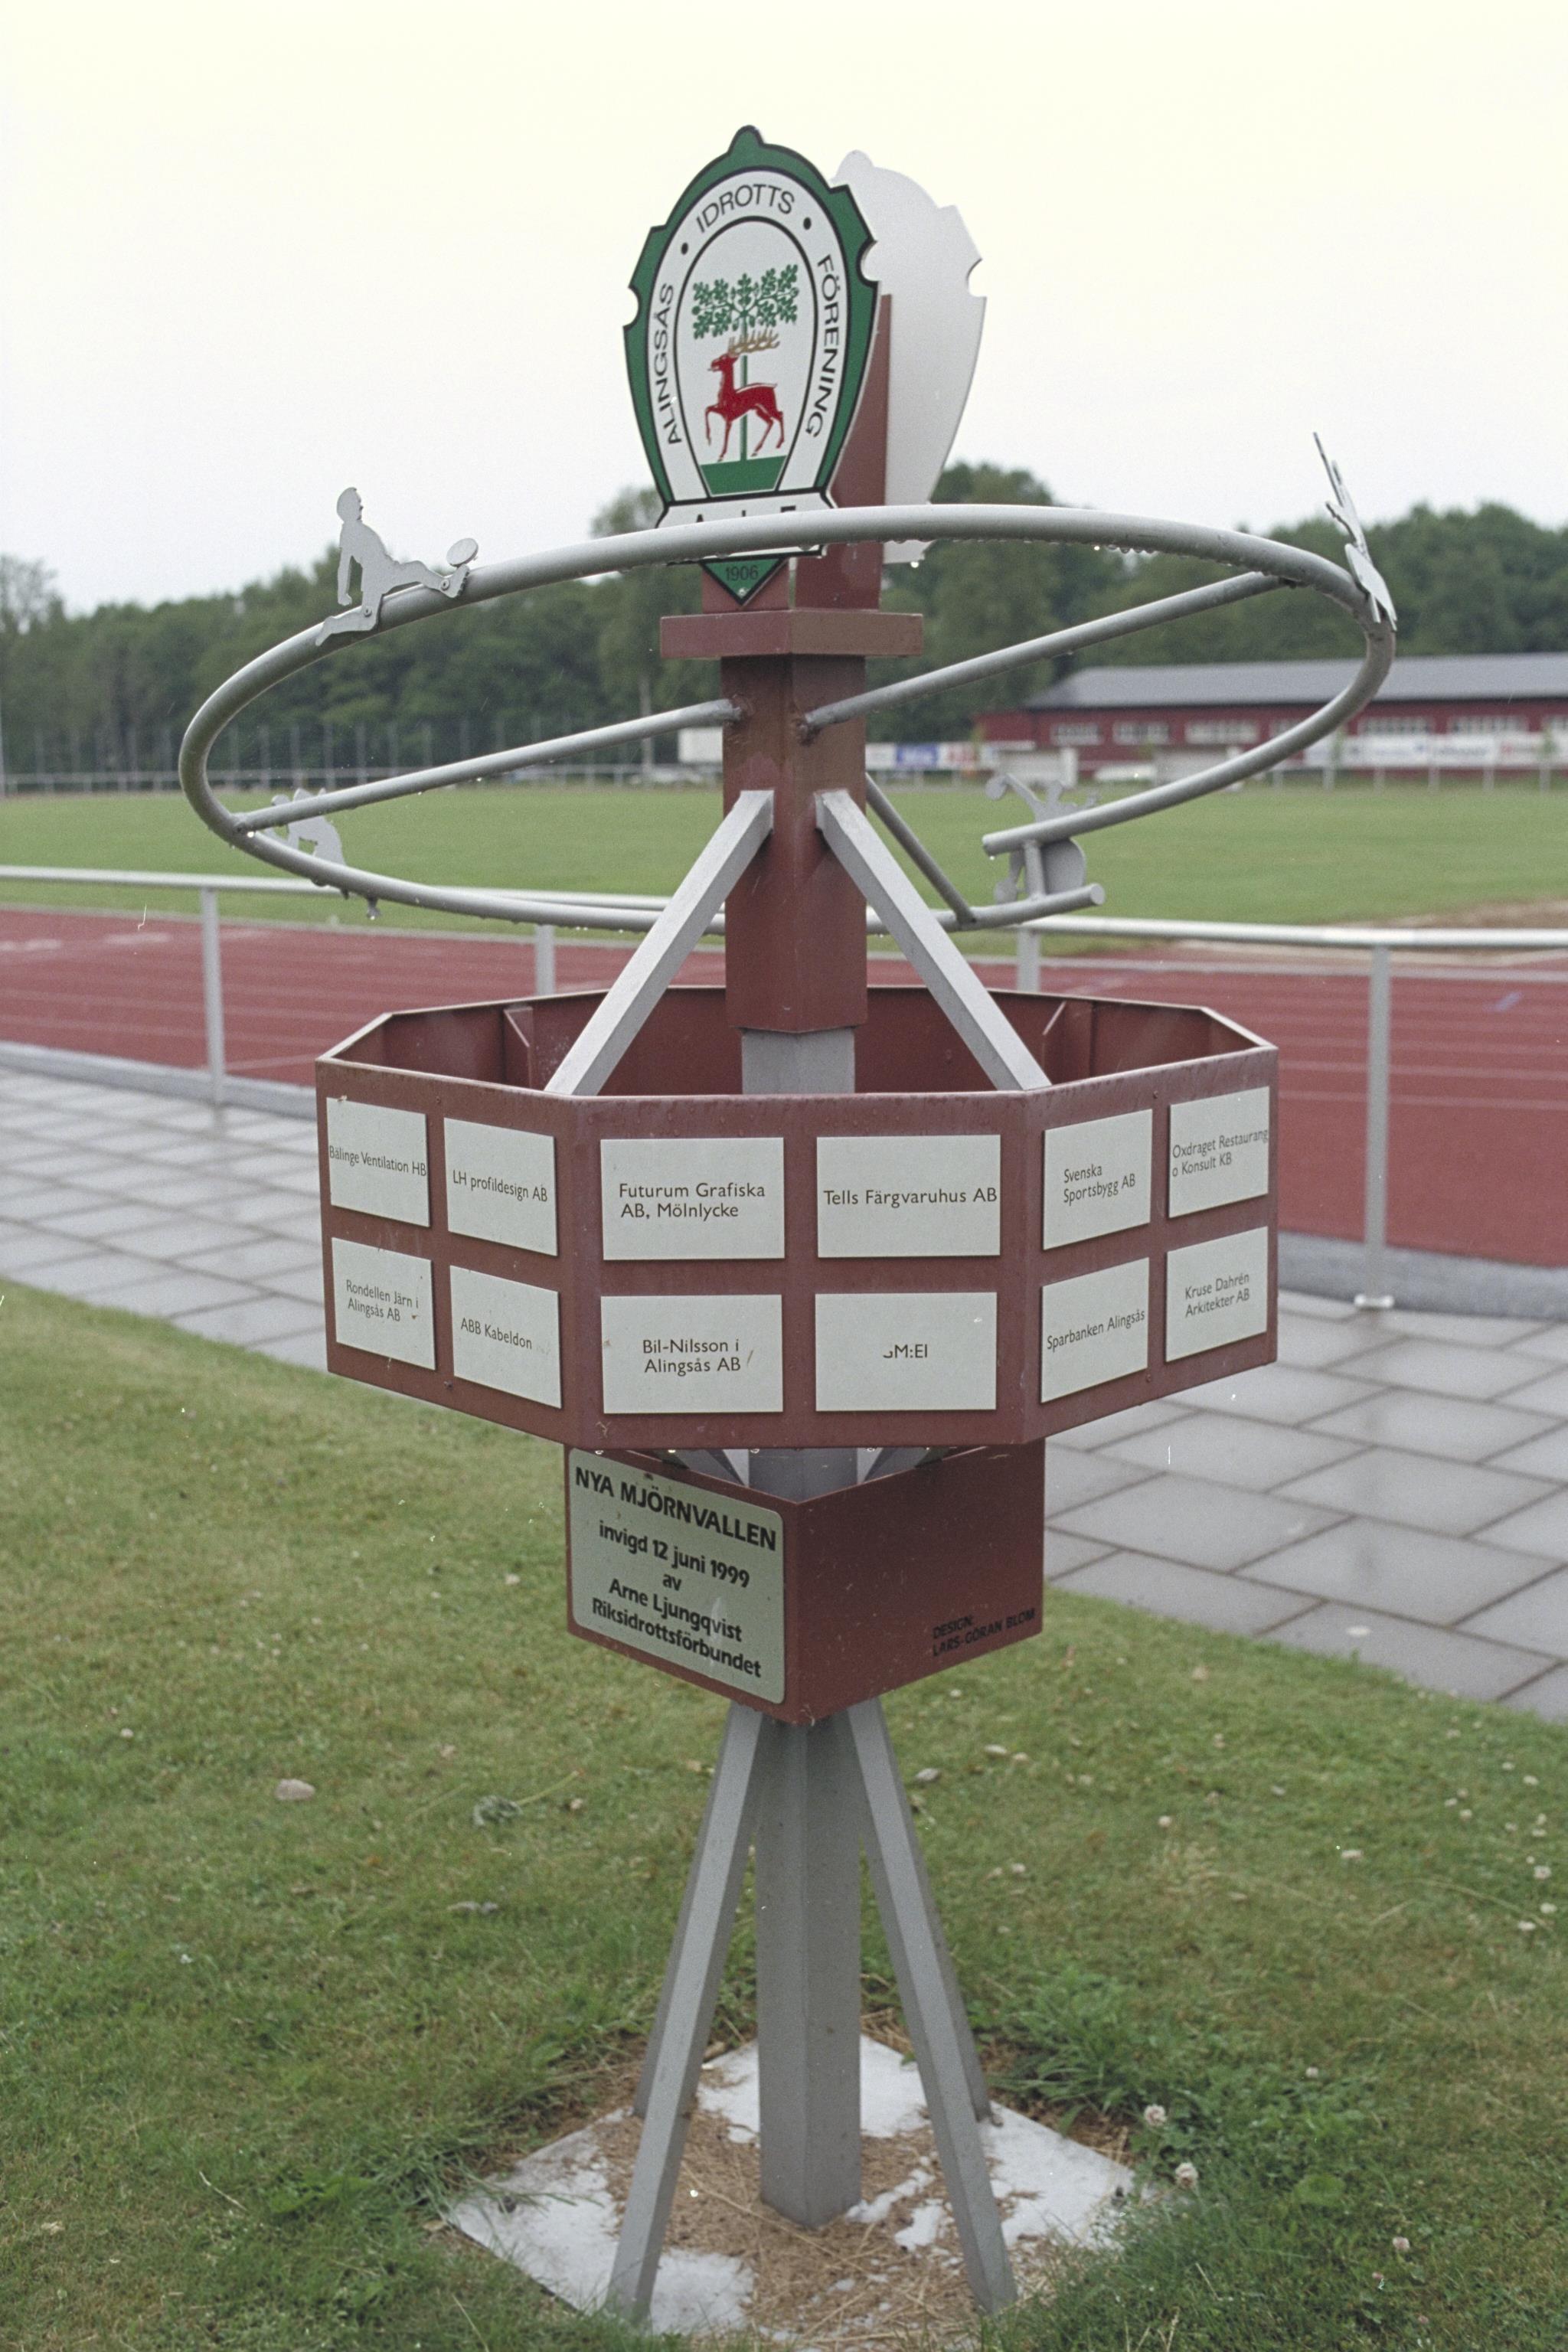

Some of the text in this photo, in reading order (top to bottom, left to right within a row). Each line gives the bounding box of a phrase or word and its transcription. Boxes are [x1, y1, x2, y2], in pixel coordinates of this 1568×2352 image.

[696, 184, 795, 233] IDROTTS
[806, 255, 841, 437] FÖRENING
[654, 283, 682, 445] ALINGSÅS
[726, 566, 759, 581] 1906
[1172, 1129, 1268, 1158] Oxdraget Restaurang
[329, 1145, 426, 1177] Bälinge Ventilation HB
[1063, 1164, 1102, 1184] Svenska
[1181, 1155, 1216, 1175] Konsult
[1219, 1152, 1232, 1166] KB
[453, 1170, 547, 1202] LH profildesign AB
[619, 1182, 765, 1197] Futurum Grafiska
[824, 1187, 998, 1208] Tells Färgvaruhus AB
[1063, 1173, 1136, 1207] Sportsbygg AB
[621, 1203, 739, 1222] AB, Mölnlycke
[346, 1279, 419, 1308] Rondellen Järn i
[1185, 1285, 1212, 1299] Kruse
[1185, 1288, 1250, 1318] Arkitekter AB
[348, 1298, 400, 1321] Alingsås AB
[461, 1318, 532, 1349] ABB Kabeldon
[1047, 1308, 1145, 1353] Sparbanken Alingsås
[643, 1339, 728, 1354] Bil-Nilsson
[645, 1357, 741, 1377] Alingsås AB
[576, 1467, 776, 1551] NYA MJÖRNVALLEN
[599, 1521, 750, 1588] invigd 12 juni 1999
[662, 1574, 681, 1591] av
[609, 1579, 742, 1642] Arne Ljungqvist
[1006, 1608, 1036, 1628] BLOM
[593, 1597, 761, 1678] Riksidrottsförbundet
